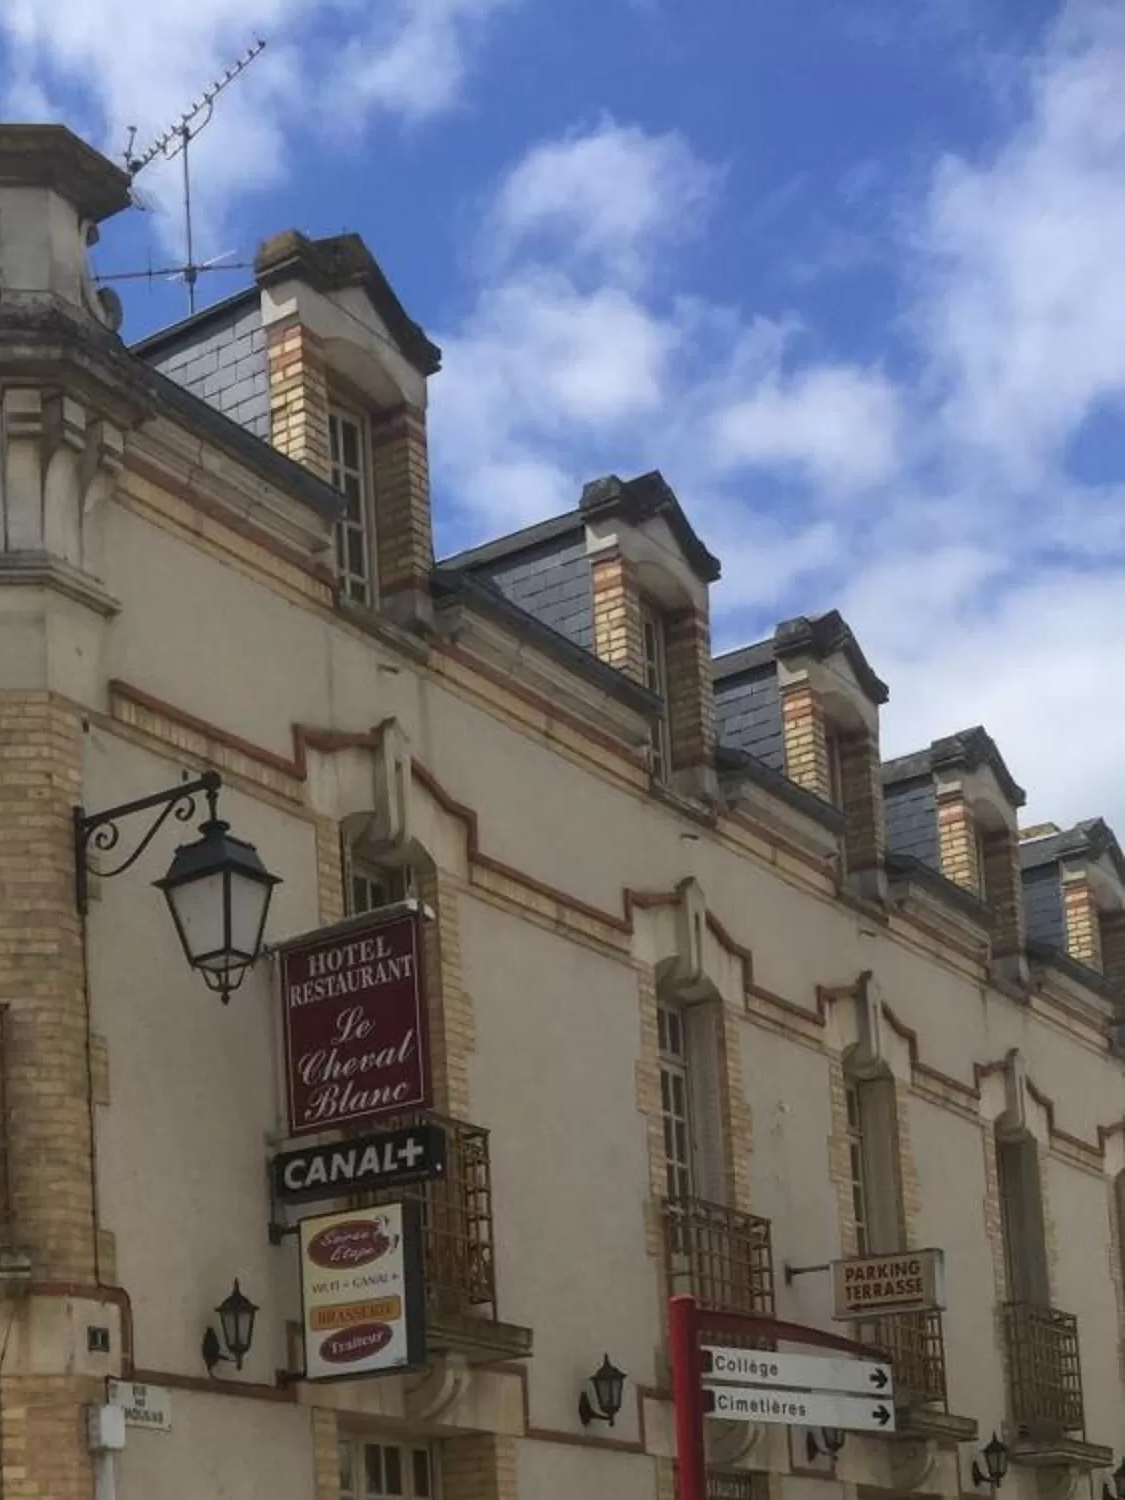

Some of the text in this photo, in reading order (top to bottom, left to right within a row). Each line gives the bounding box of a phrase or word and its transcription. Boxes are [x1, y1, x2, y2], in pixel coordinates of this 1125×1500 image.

[309, 935, 392, 977] HOTEL
[290, 954, 412, 1008] RESTAURANT
[331, 1004, 375, 1045] Le
[298, 1028, 416, 1086] Cheval
[304, 1080, 411, 1121] Blanc
[283, 1137, 424, 1190] CANAL+
[845, 1260, 920, 1282] PARKING
[845, 1278, 923, 1300] TERRASSE
